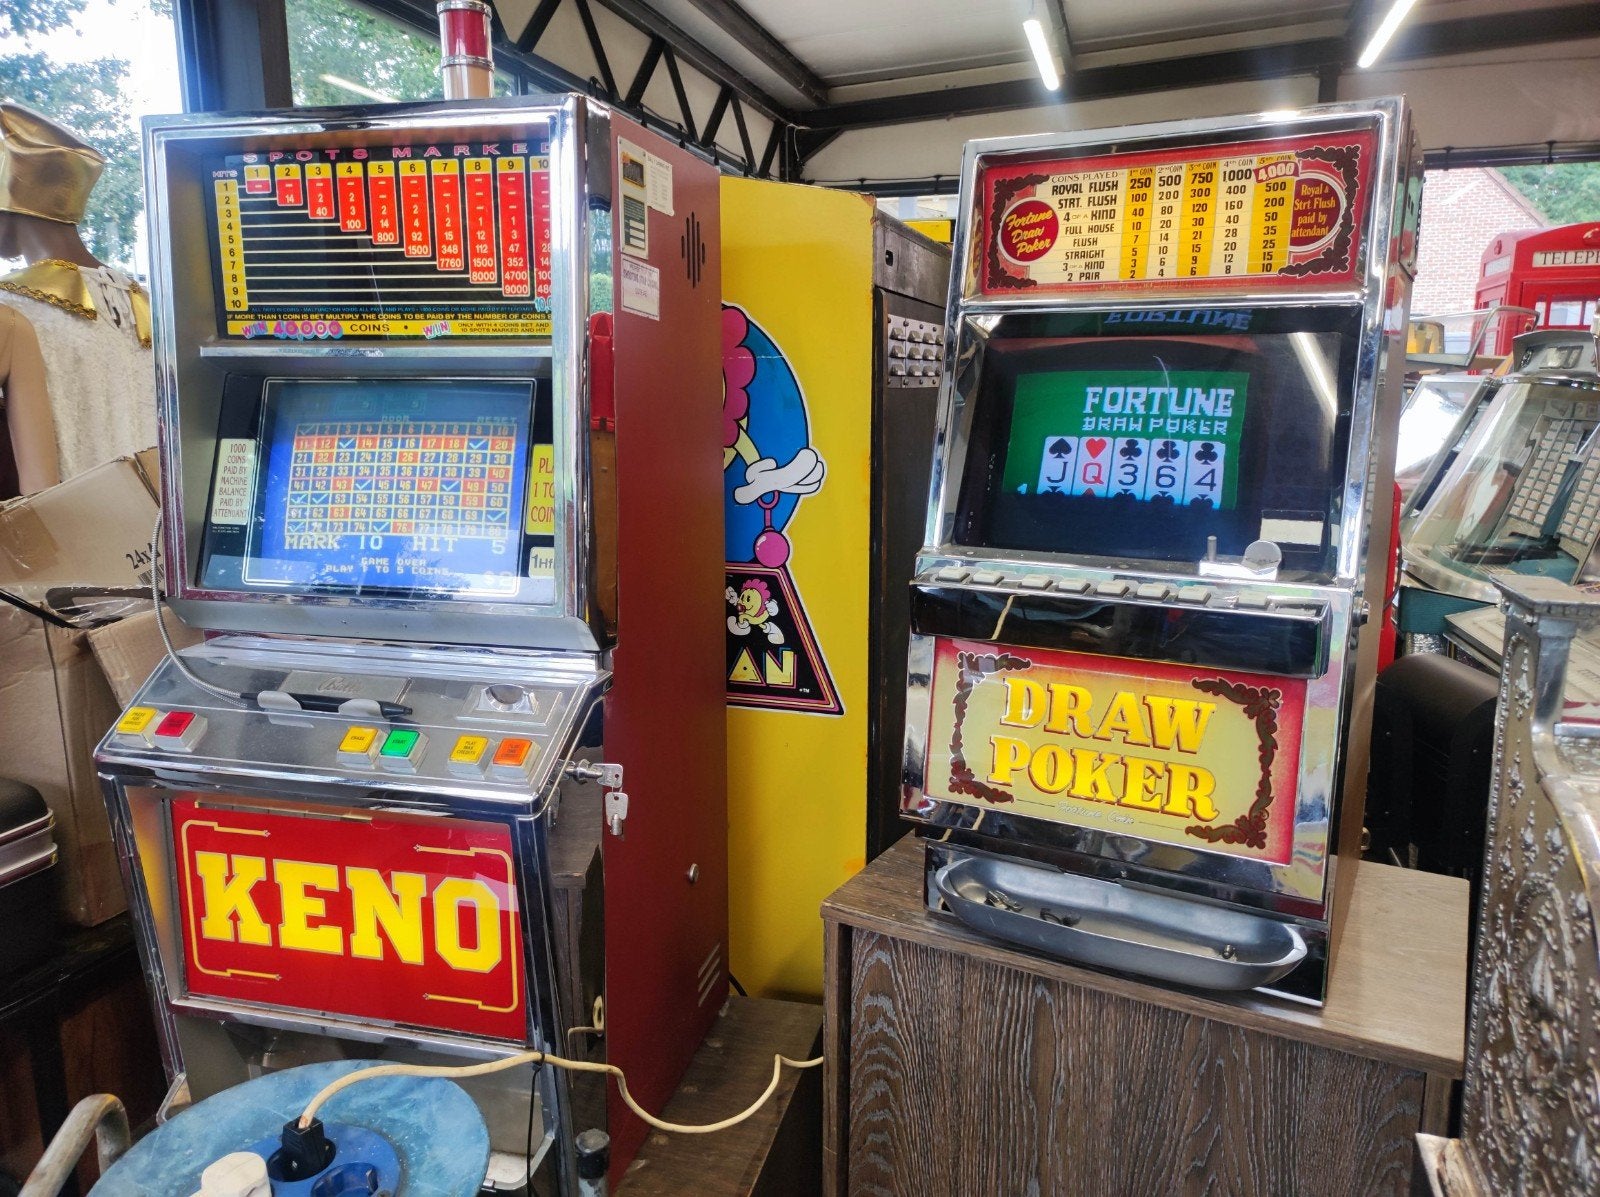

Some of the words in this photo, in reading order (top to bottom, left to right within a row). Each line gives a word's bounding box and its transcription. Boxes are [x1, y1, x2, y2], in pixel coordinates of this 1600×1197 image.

[212, 170, 238, 178] HITS
[1052, 173, 1080, 184] COINS
[1083, 171, 1118, 181] PLAYED
[1130, 177, 1152, 190] 250
[1158, 174, 1181, 187] 500
[1190, 172, 1213, 184] 750
[1222, 168, 1252, 182] 1000
[1258, 162, 1295, 181] 4,000
[1052, 184, 1082, 196] ROYAL
[1089, 180, 1118, 194] FLUSH
[1131, 193, 1147, 203] 100
[1159, 190, 1179, 200] 200
[1190, 188, 1211, 198] 300
[1226, 185, 1246, 195] 400
[1265, 182, 1287, 192] 500
[1302, 184, 1322, 196] Royal
[285, 194, 294, 204] 14
[1058, 197, 1082, 210] STRT.
[1088, 194, 1117, 207] FLUSH
[1294, 198, 1311, 210] Strt
[1314, 197, 1336, 208] Flush
[316, 206, 328, 216] 40
[1132, 208, 1144, 217] 40
[1161, 206, 1173, 215] 80
[1192, 203, 1208, 212] 120
[1225, 200, 1243, 210] 160
[1264, 197, 1284, 208] 200
[1006, 210, 1053, 230] Fortune
[1063, 212, 1070, 222] 4
[1090, 208, 1116, 221] KIND
[1298, 212, 1316, 226] paid
[1318, 212, 1327, 224] by
[346, 219, 362, 229] 100
[380, 219, 390, 228] 14
[1132, 222, 1142, 230] 10
[1160, 220, 1171, 228] 20
[1192, 217, 1204, 226] 30
[1226, 215, 1239, 224] 40
[1265, 212, 1278, 221] 50
[1065, 226, 1082, 235] FULL
[1088, 223, 1114, 234] HOUSE
[1160, 233, 1169, 242] 14
[1193, 231, 1202, 240] 21
[1225, 228, 1237, 238] 28
[1264, 226, 1277, 236] 35
[1292, 226, 1329, 237] attendant
[376, 232, 394, 242] 800
[412, 232, 422, 242] 92
[444, 231, 454, 240] 15
[476, 230, 486, 240] 12
[1011, 226, 1044, 244] Draw
[1073, 237, 1098, 247] FLUSH
[408, 245, 428, 255] 1500
[442, 244, 458, 254] 348
[476, 244, 488, 254] 112
[508, 243, 520, 253] 47
[1016, 238, 1051, 257] Poker
[1159, 246, 1168, 255] 10
[1192, 244, 1201, 253] 15
[1224, 242, 1236, 251] 20
[1263, 240, 1275, 249] 25
[1065, 250, 1105, 261] STRAIGHT
[1224, 254, 1233, 263] 12
[1263, 252, 1273, 261] 15
[440, 258, 462, 268] 7760
[473, 258, 494, 268] 1500
[507, 257, 524, 267] 352
[1063, 262, 1068, 272] 3
[1084, 260, 1105, 270] KIND
[1262, 263, 1272, 272] 10
[472, 271, 495, 280] 8000
[504, 270, 527, 280] 4700
[1068, 272, 1073, 282] 2
[1079, 272, 1100, 281] PAIR
[504, 284, 528, 294] 9000
[242, 321, 268, 340] WIN
[350, 324, 390, 332] COINS
[422, 320, 450, 340] WIN
[1082, 386, 1234, 417] FORTUNE
[1082, 416, 1143, 432] DRAW
[1149, 418, 1228, 435] POKER
[230, 444, 246, 453] 1000
[228, 456, 246, 464] COINS
[223, 466, 237, 474] PAID
[238, 466, 247, 474] BY
[221, 477, 248, 485] MACHINE
[1046, 461, 1069, 483] J
[1082, 462, 1104, 485] Q
[1118, 463, 1139, 486] 3
[1155, 465, 1176, 488] 6
[1194, 468, 1216, 492] 4
[219, 488, 247, 496] BALANCE
[533, 482, 538, 497] 1
[220, 498, 234, 507] PAID
[235, 498, 243, 506] BY
[214, 509, 247, 518] ATTENDANT
[284, 534, 340, 550] MARK
[360, 535, 383, 550] 10
[413, 536, 458, 552] HIT
[492, 540, 506, 555] 5
[361, 557, 390, 565] GAME
[397, 559, 426, 567] OVER
[326, 564, 353, 573] PLAY
[1000, 676, 1217, 754] DRAW
[988, 735, 1220, 822] POKER
[194, 850, 502, 974] KENO
